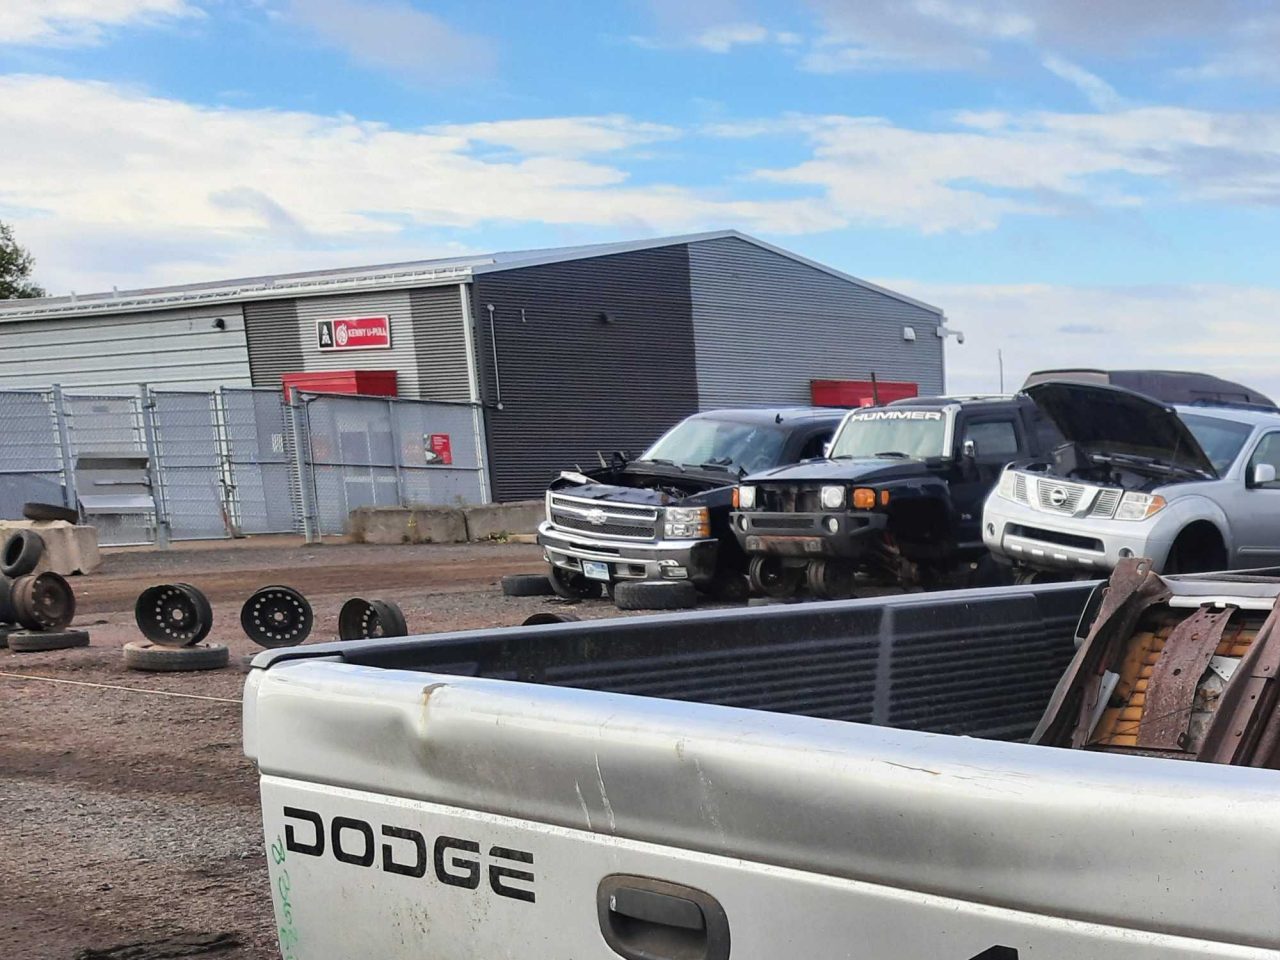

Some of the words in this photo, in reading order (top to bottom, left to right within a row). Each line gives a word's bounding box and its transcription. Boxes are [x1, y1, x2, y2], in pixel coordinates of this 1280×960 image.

[348, 328, 366, 337] KENNY
[852, 411, 941, 422] HUMMER
[284, 806, 536, 903] DODGE
